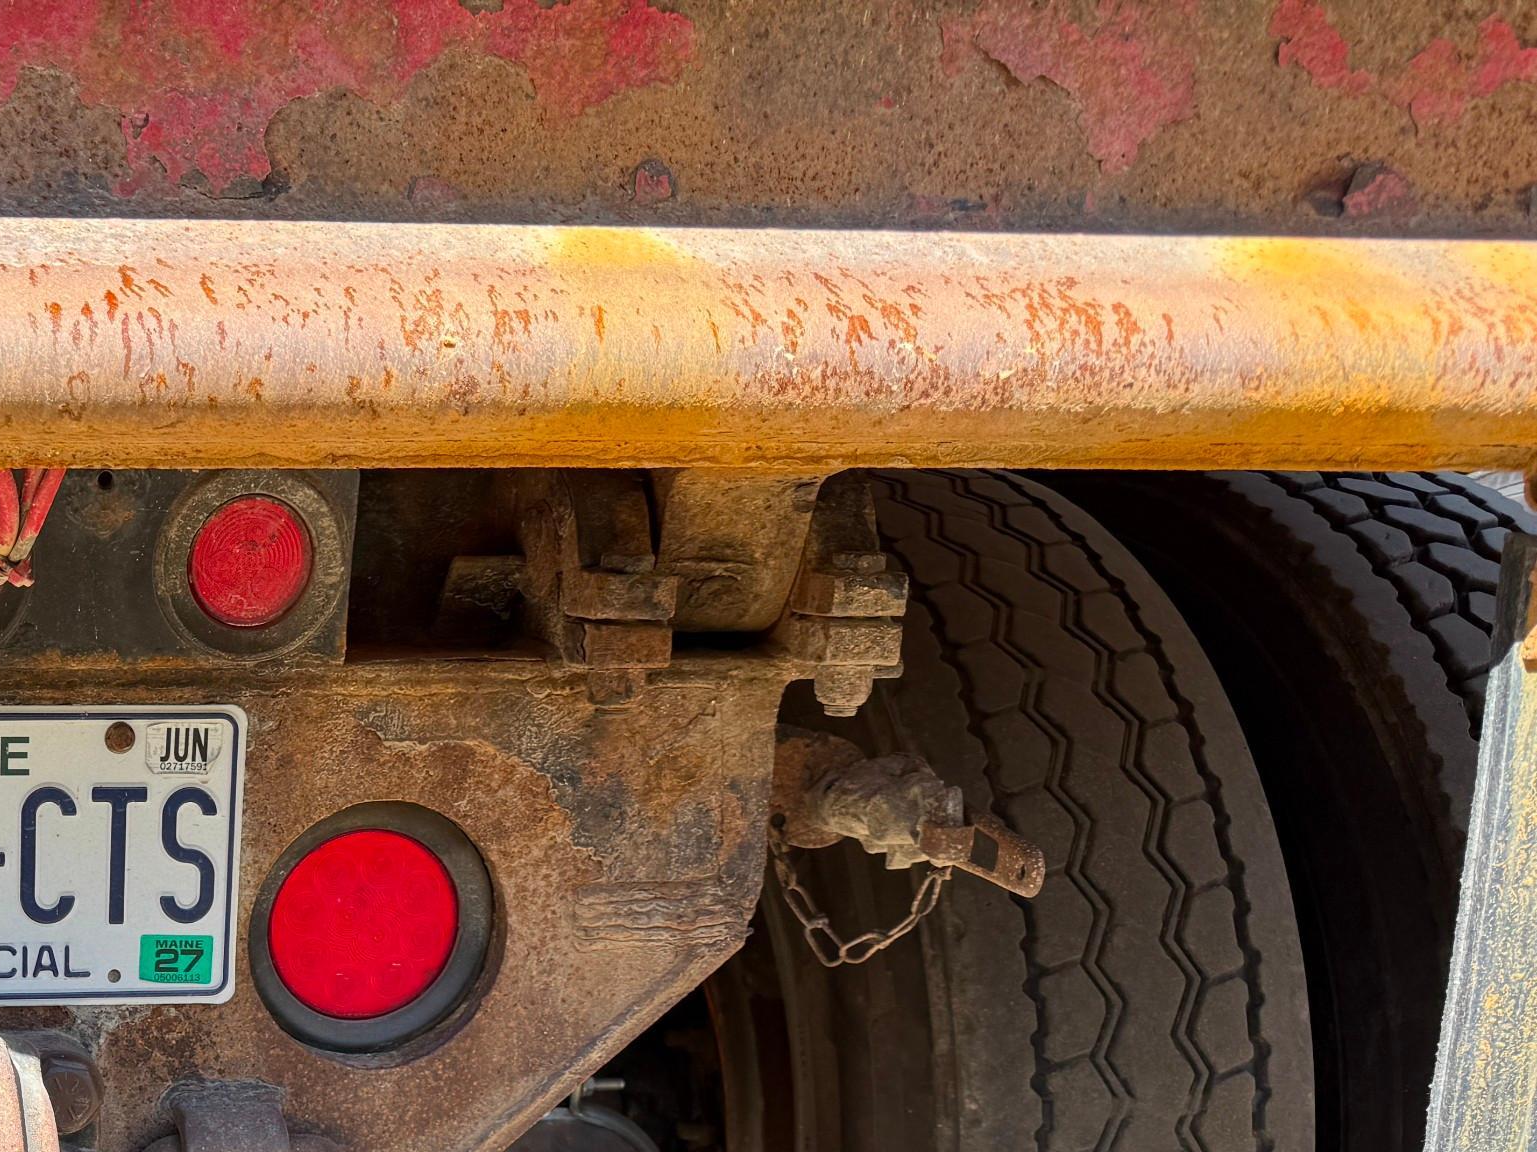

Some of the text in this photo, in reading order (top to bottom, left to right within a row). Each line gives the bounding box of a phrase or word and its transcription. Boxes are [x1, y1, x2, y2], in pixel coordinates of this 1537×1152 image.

[160, 727, 209, 762] JUN
[155, 939, 204, 949] MAINE
[155, 948, 205, 972] 27
